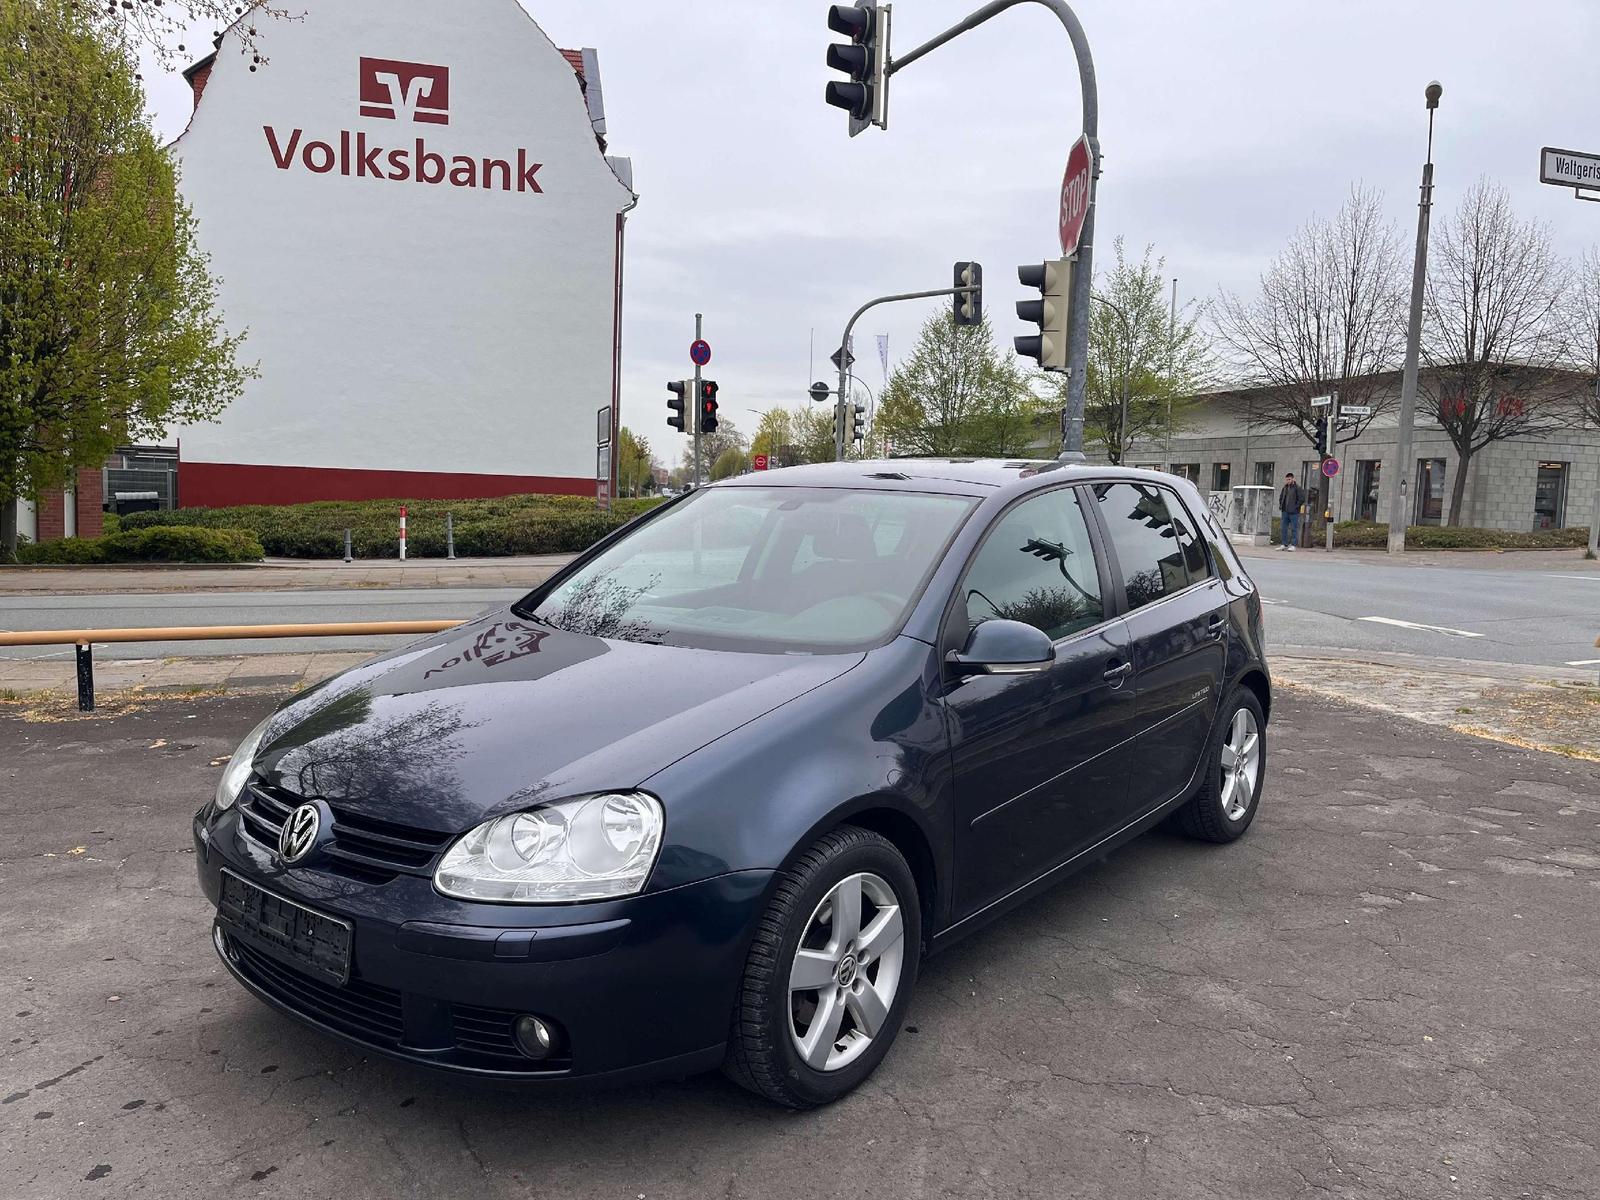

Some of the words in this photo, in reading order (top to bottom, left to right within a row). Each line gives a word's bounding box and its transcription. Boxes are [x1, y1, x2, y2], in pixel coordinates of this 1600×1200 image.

[263, 125, 544, 194] Volksbank
[1062, 167, 1087, 227] STOP
[280, 805, 319, 861] VW
